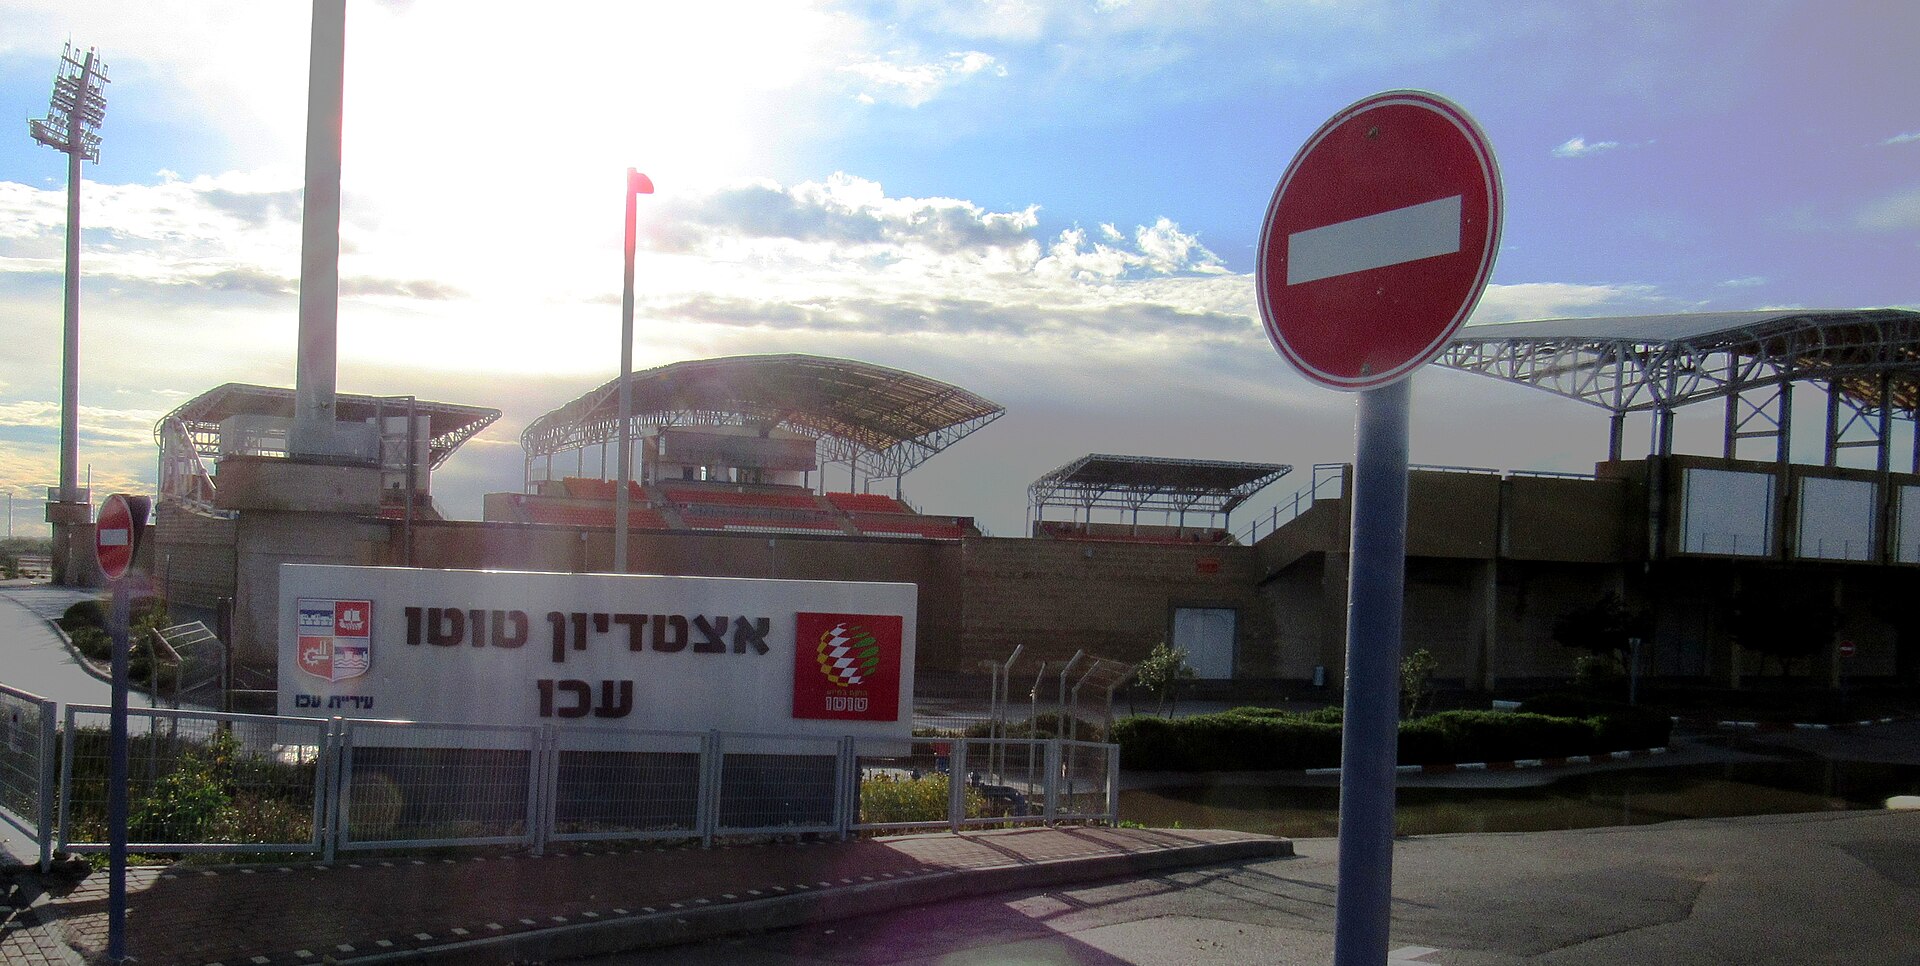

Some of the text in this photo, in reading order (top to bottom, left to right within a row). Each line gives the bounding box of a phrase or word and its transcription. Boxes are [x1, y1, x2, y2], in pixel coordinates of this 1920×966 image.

[404, 606, 771, 663] אצטדיון טוטו
[295, 694, 374, 710] עיריית עכו
[537, 679, 633, 719] עכו
[825, 696, 868, 711] טוטו
